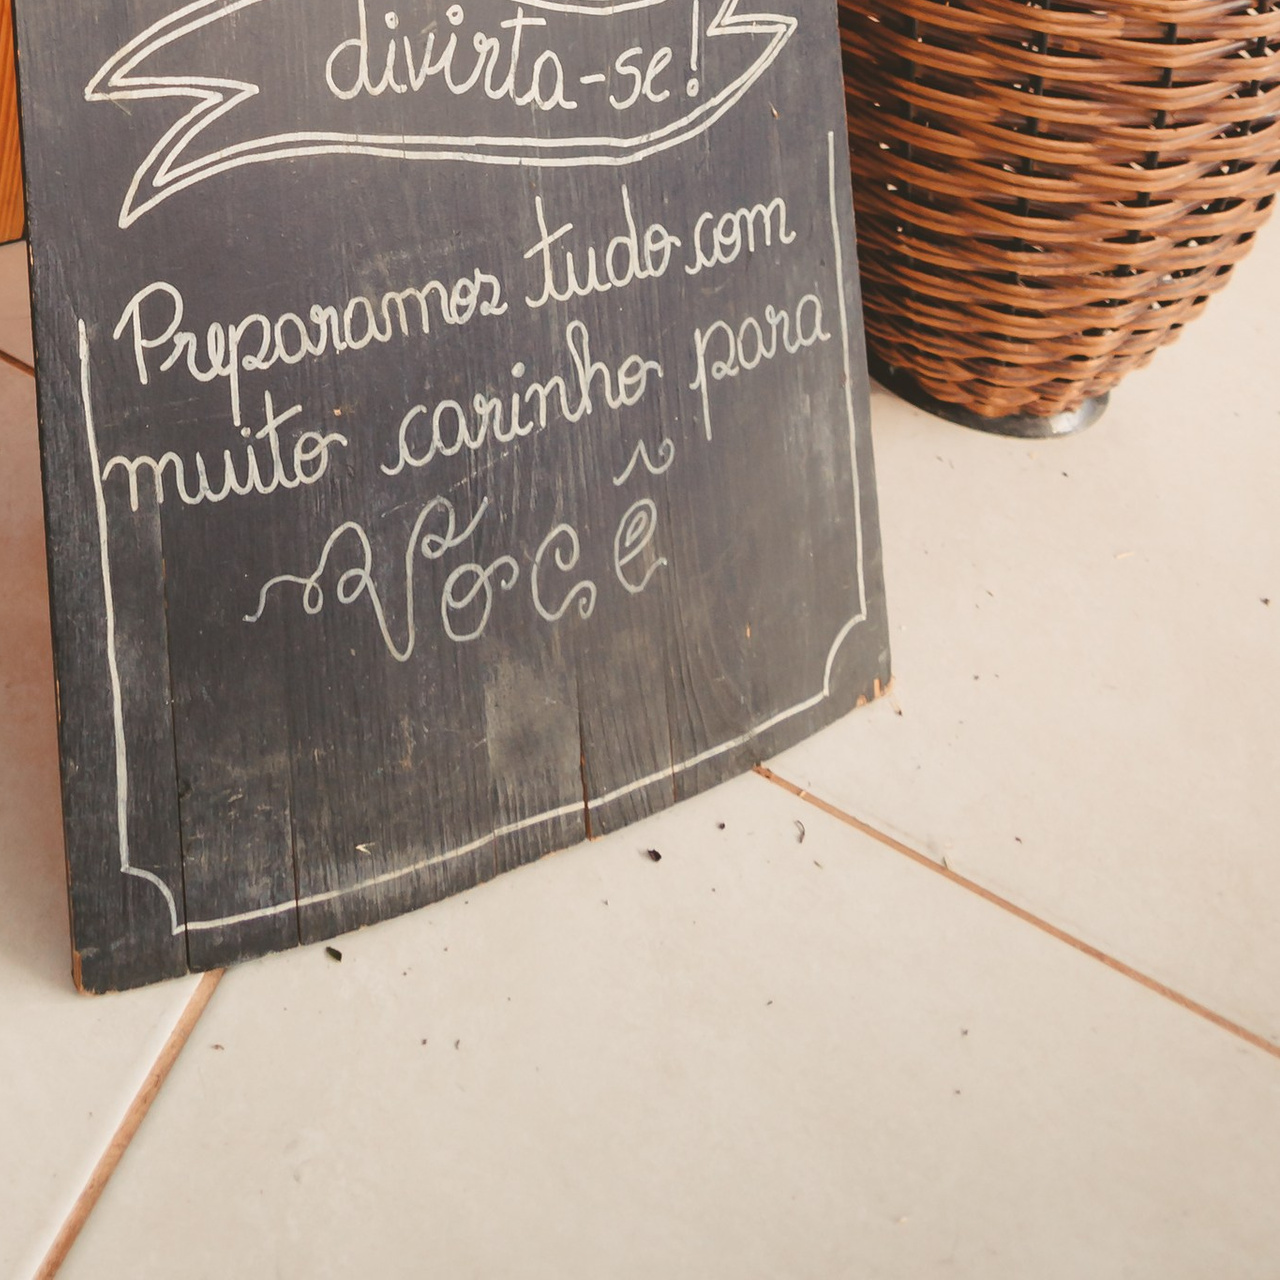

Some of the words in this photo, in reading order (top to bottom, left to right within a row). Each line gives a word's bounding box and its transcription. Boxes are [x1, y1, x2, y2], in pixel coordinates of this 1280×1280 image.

[102, 390, 349, 512] muito
[380, 319, 664, 476] carinho
[689, 293, 832, 440] para
[112, 281, 508, 436] Preparamos
[524, 184, 683, 308] tudo
[682, 195, 797, 276] com
